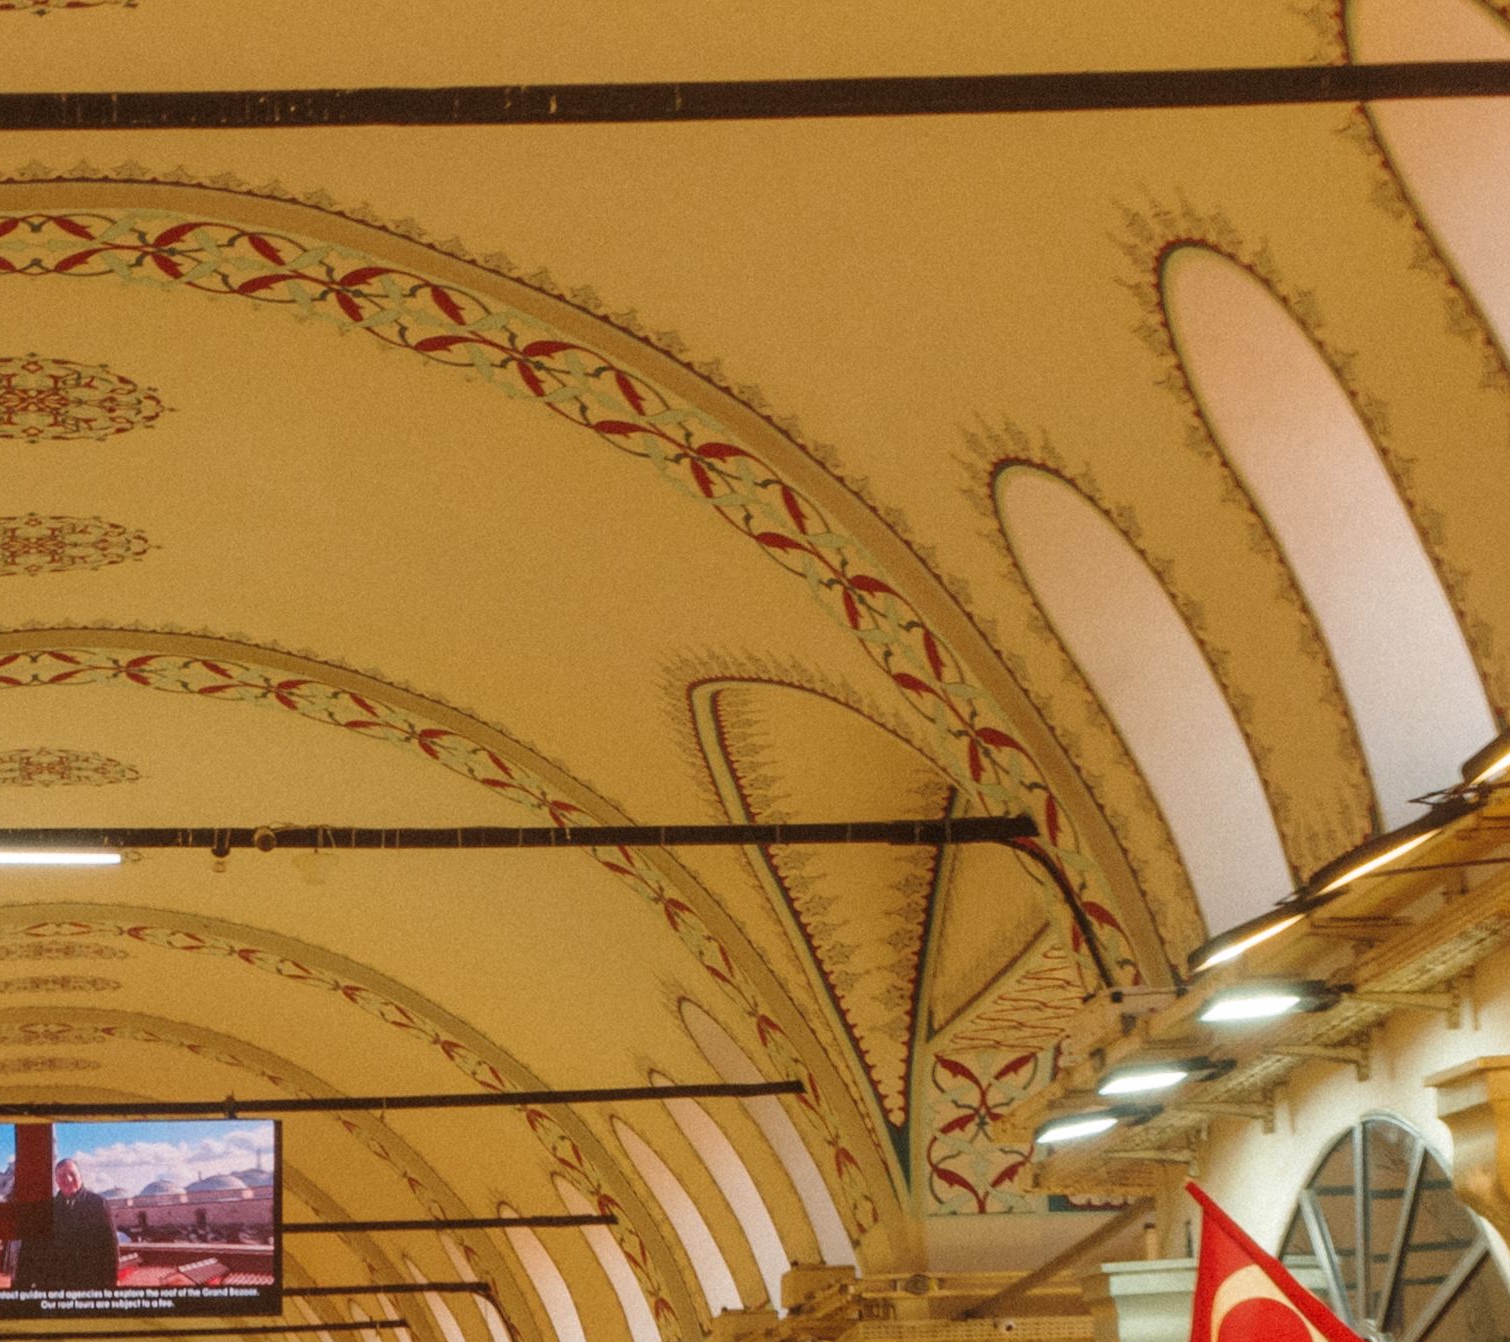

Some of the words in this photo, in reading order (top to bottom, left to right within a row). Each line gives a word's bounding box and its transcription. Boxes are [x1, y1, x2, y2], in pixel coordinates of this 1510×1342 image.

[19, 1290, 47, 1301] guides
[47, 1290, 65, 1299] and
[65, 1290, 103, 1301] agencies
[103, 1289, 113, 1299] to
[113, 1289, 145, 1300] explore
[145, 1288, 159, 1298] the
[160, 1288, 178, 1298] roof
[178, 1288, 187, 1297] of
[187, 1288, 201, 1297] the
[202, 1287, 228, 1297] Grand
[40, 1300, 57, 1310] Our
[57, 1300, 74, 1309] roof
[75, 1299, 95, 1309] tours
[95, 1300, 110, 1309] are
[111, 1299, 141, 1310] subject
[141, 1299, 150, 1308] to
